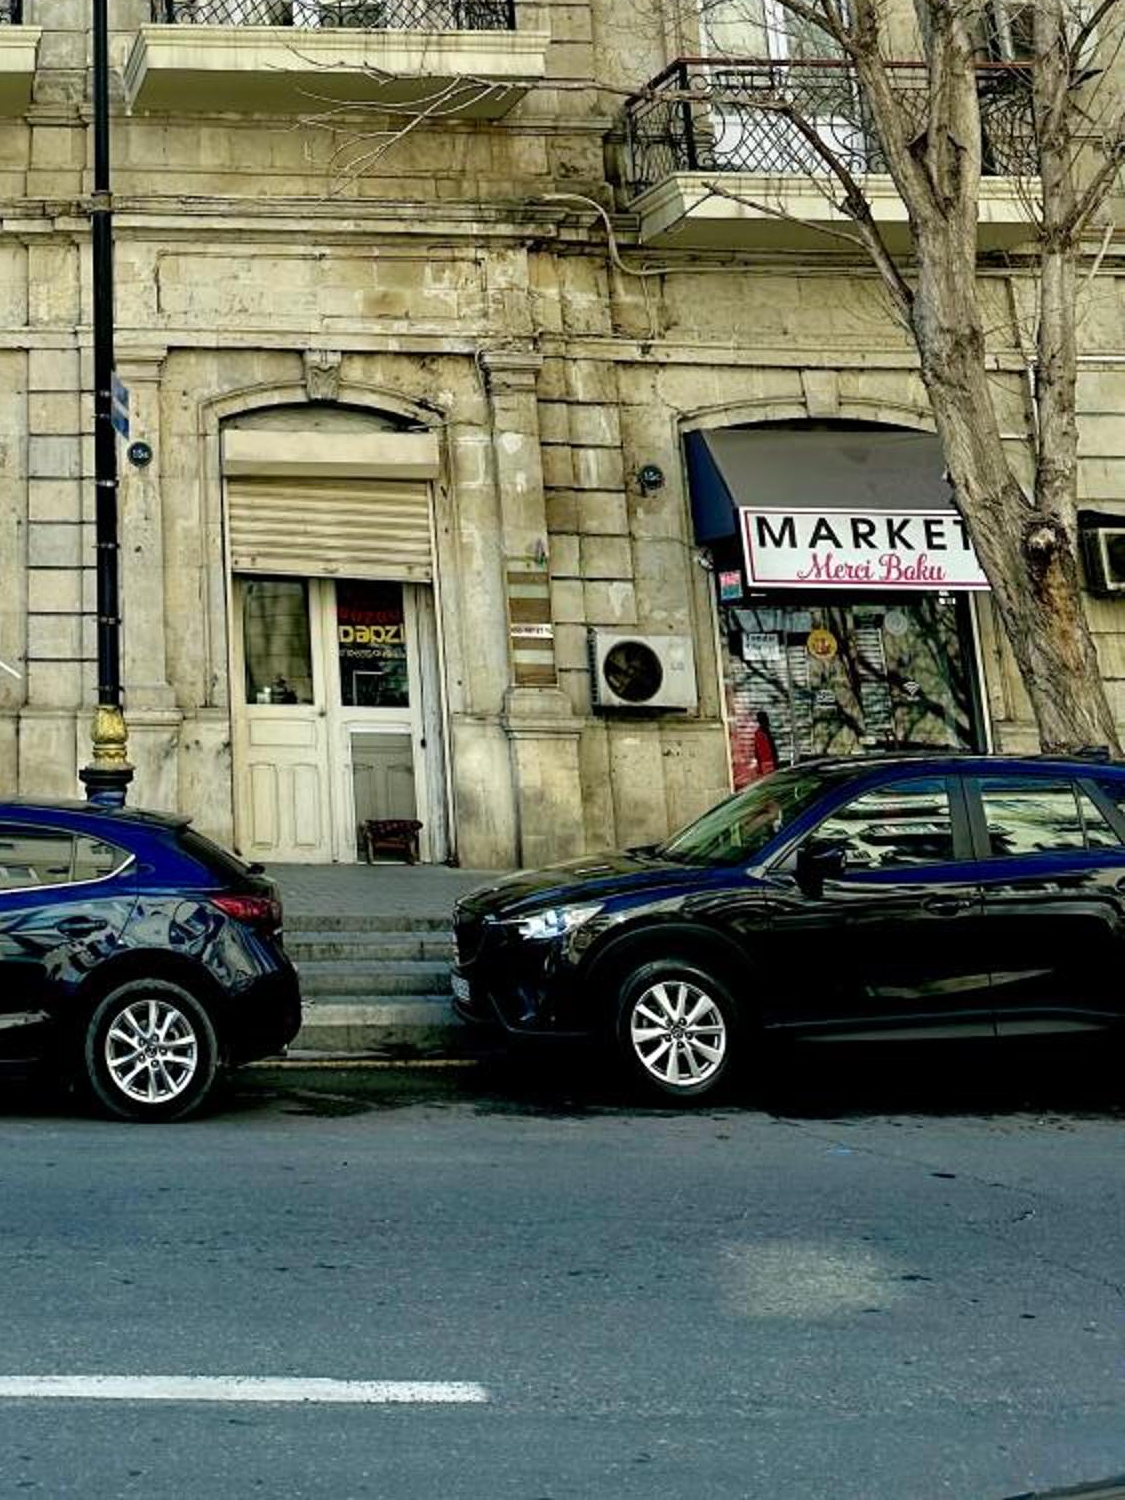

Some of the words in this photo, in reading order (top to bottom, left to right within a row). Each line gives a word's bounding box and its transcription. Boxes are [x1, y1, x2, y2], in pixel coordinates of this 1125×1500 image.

[756, 516, 971, 550] MARKET
[797, 553, 873, 580] Merci
[878, 553, 946, 581] Baku
